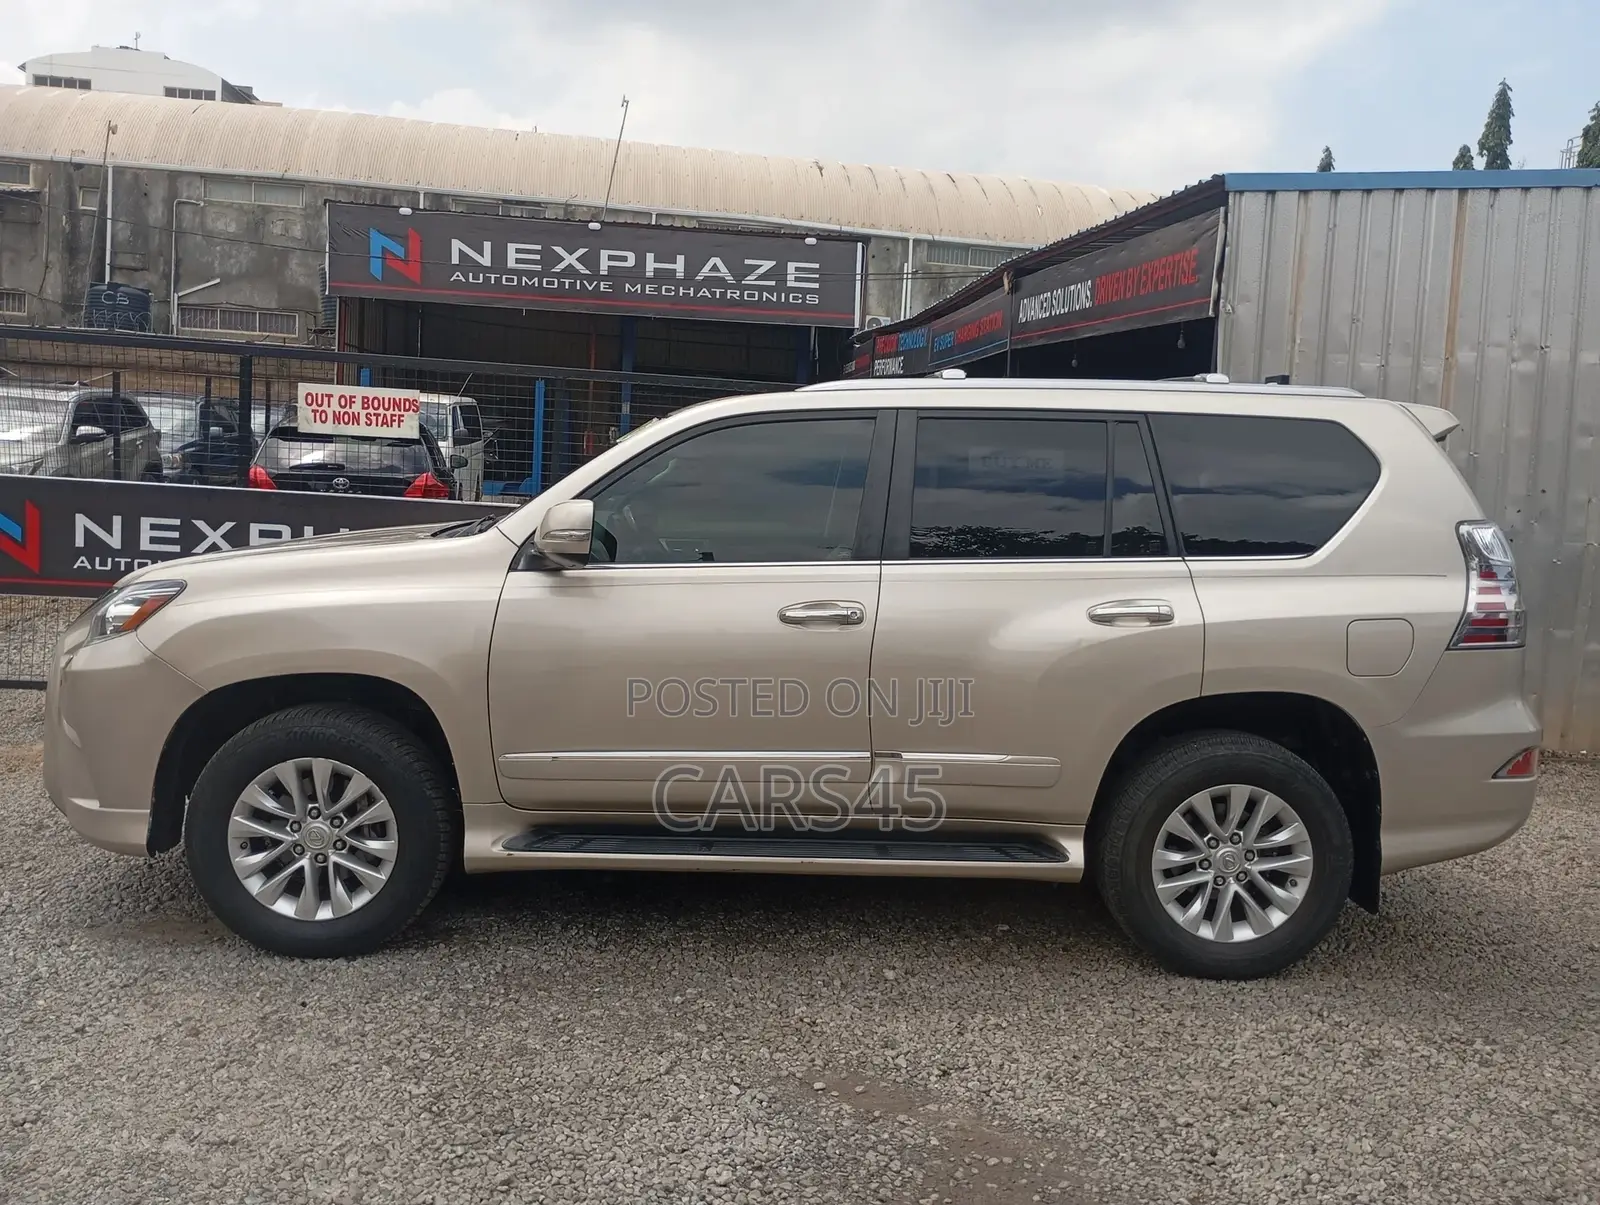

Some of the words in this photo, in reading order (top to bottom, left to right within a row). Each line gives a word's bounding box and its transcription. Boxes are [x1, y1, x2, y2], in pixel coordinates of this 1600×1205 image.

[450, 238, 820, 289] NEXPHAZE
[449, 270, 614, 293] AUTOMOTIVE
[624, 282, 820, 305] MECHATRONICS
[1018, 291, 1051, 324] ADVANCED
[1051, 279, 1093, 316] SOLUTIONS.
[1094, 269, 1127, 306] DRIVEN
[1127, 264, 1141, 298] BY
[304, 391, 334, 409] OUT
[337, 394, 357, 410] OF
[361, 395, 420, 414] BOUNDS
[311, 409, 328, 425] TO
[332, 410, 361, 427] NON
[364, 412, 405, 429] STAFF
